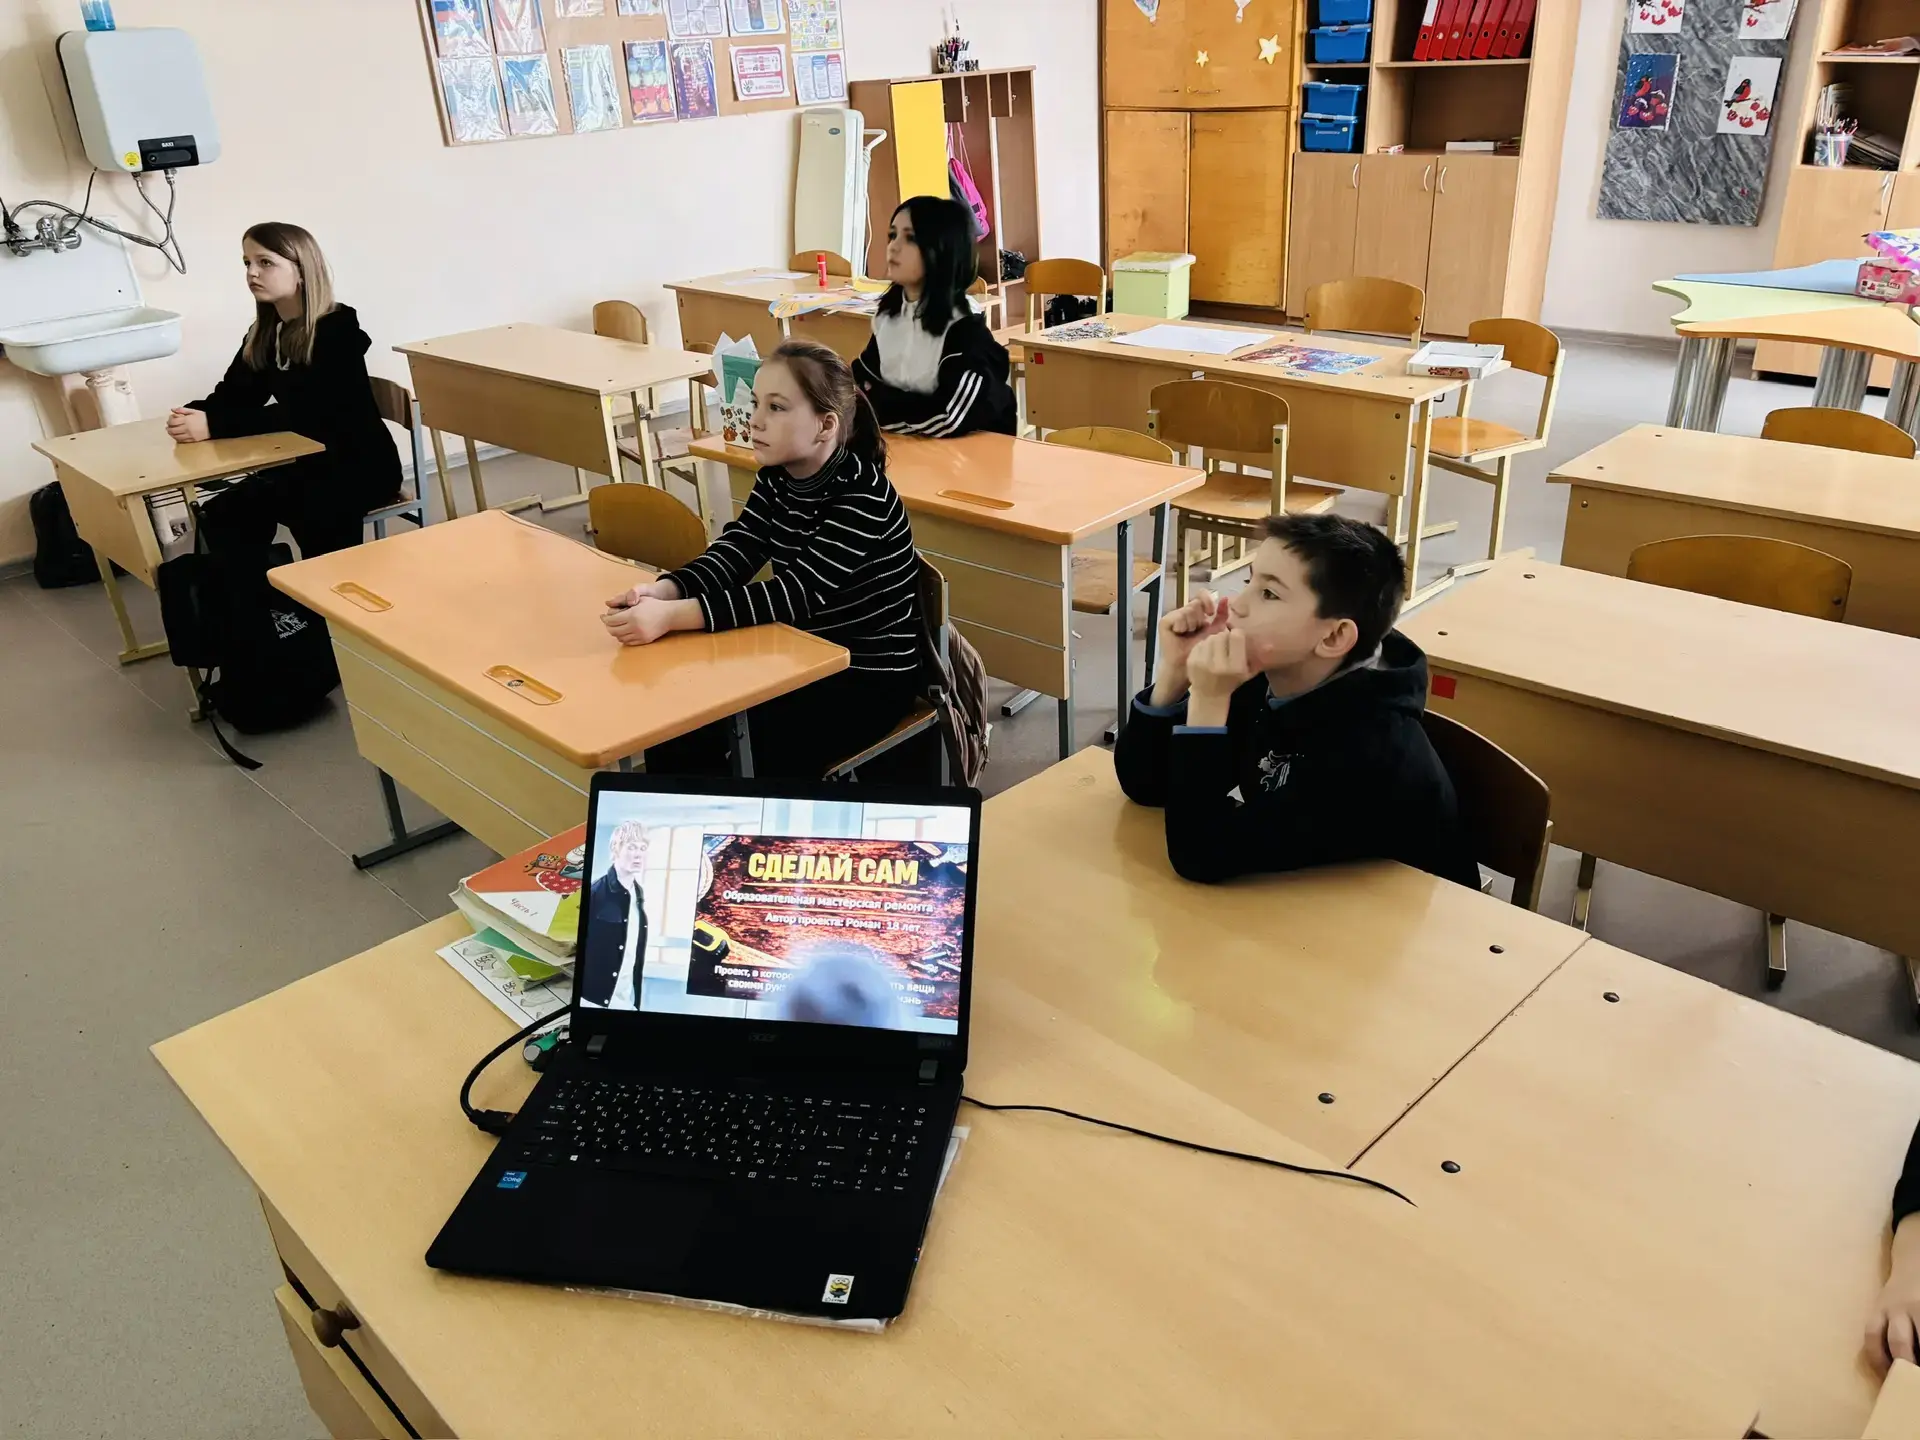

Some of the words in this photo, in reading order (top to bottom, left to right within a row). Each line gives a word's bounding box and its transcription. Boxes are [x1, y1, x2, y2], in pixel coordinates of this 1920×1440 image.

[748, 852, 853, 882] СДЕЛАЙ
[858, 858, 919, 885] САМ
[722, 890, 816, 905] Образовательная
[817, 897, 882, 909] мастерская
[884, 901, 934, 912] ремонта
[764, 912, 797, 925] Автор
[798, 916, 844, 927] проекта:
[714, 965, 751, 978] Проект,
[727, 979, 764, 990] своими
[907, 983, 936, 995] вещи
